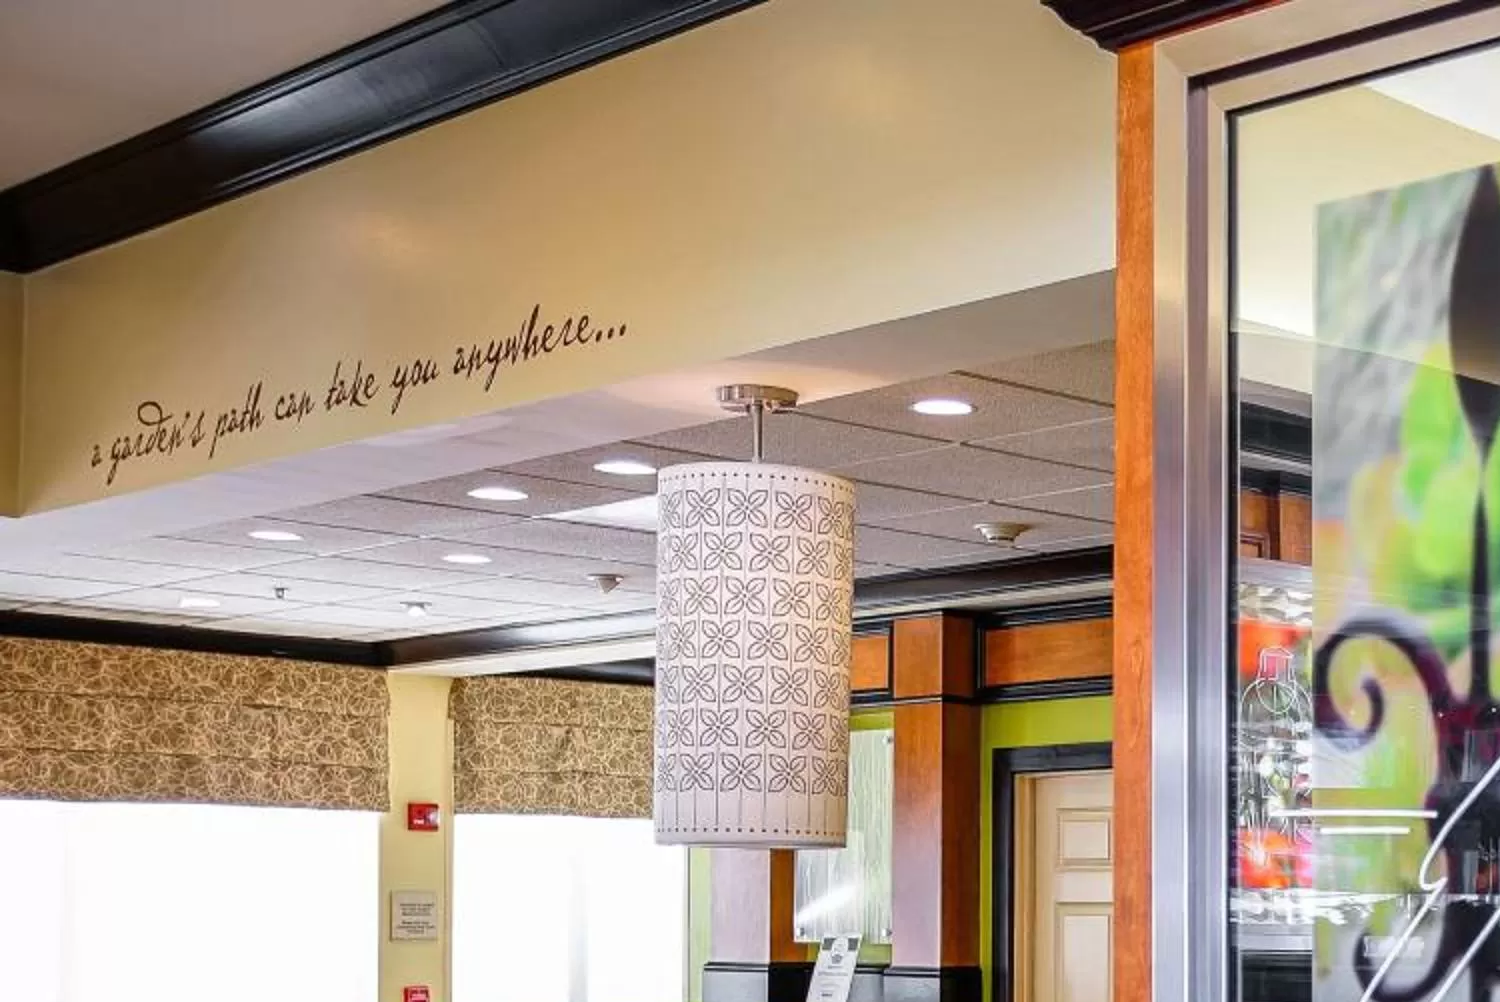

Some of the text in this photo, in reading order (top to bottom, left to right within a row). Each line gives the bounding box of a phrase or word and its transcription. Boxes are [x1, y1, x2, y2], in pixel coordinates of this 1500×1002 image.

[91, 303, 627, 486] a garden's path can take you anywhere...
